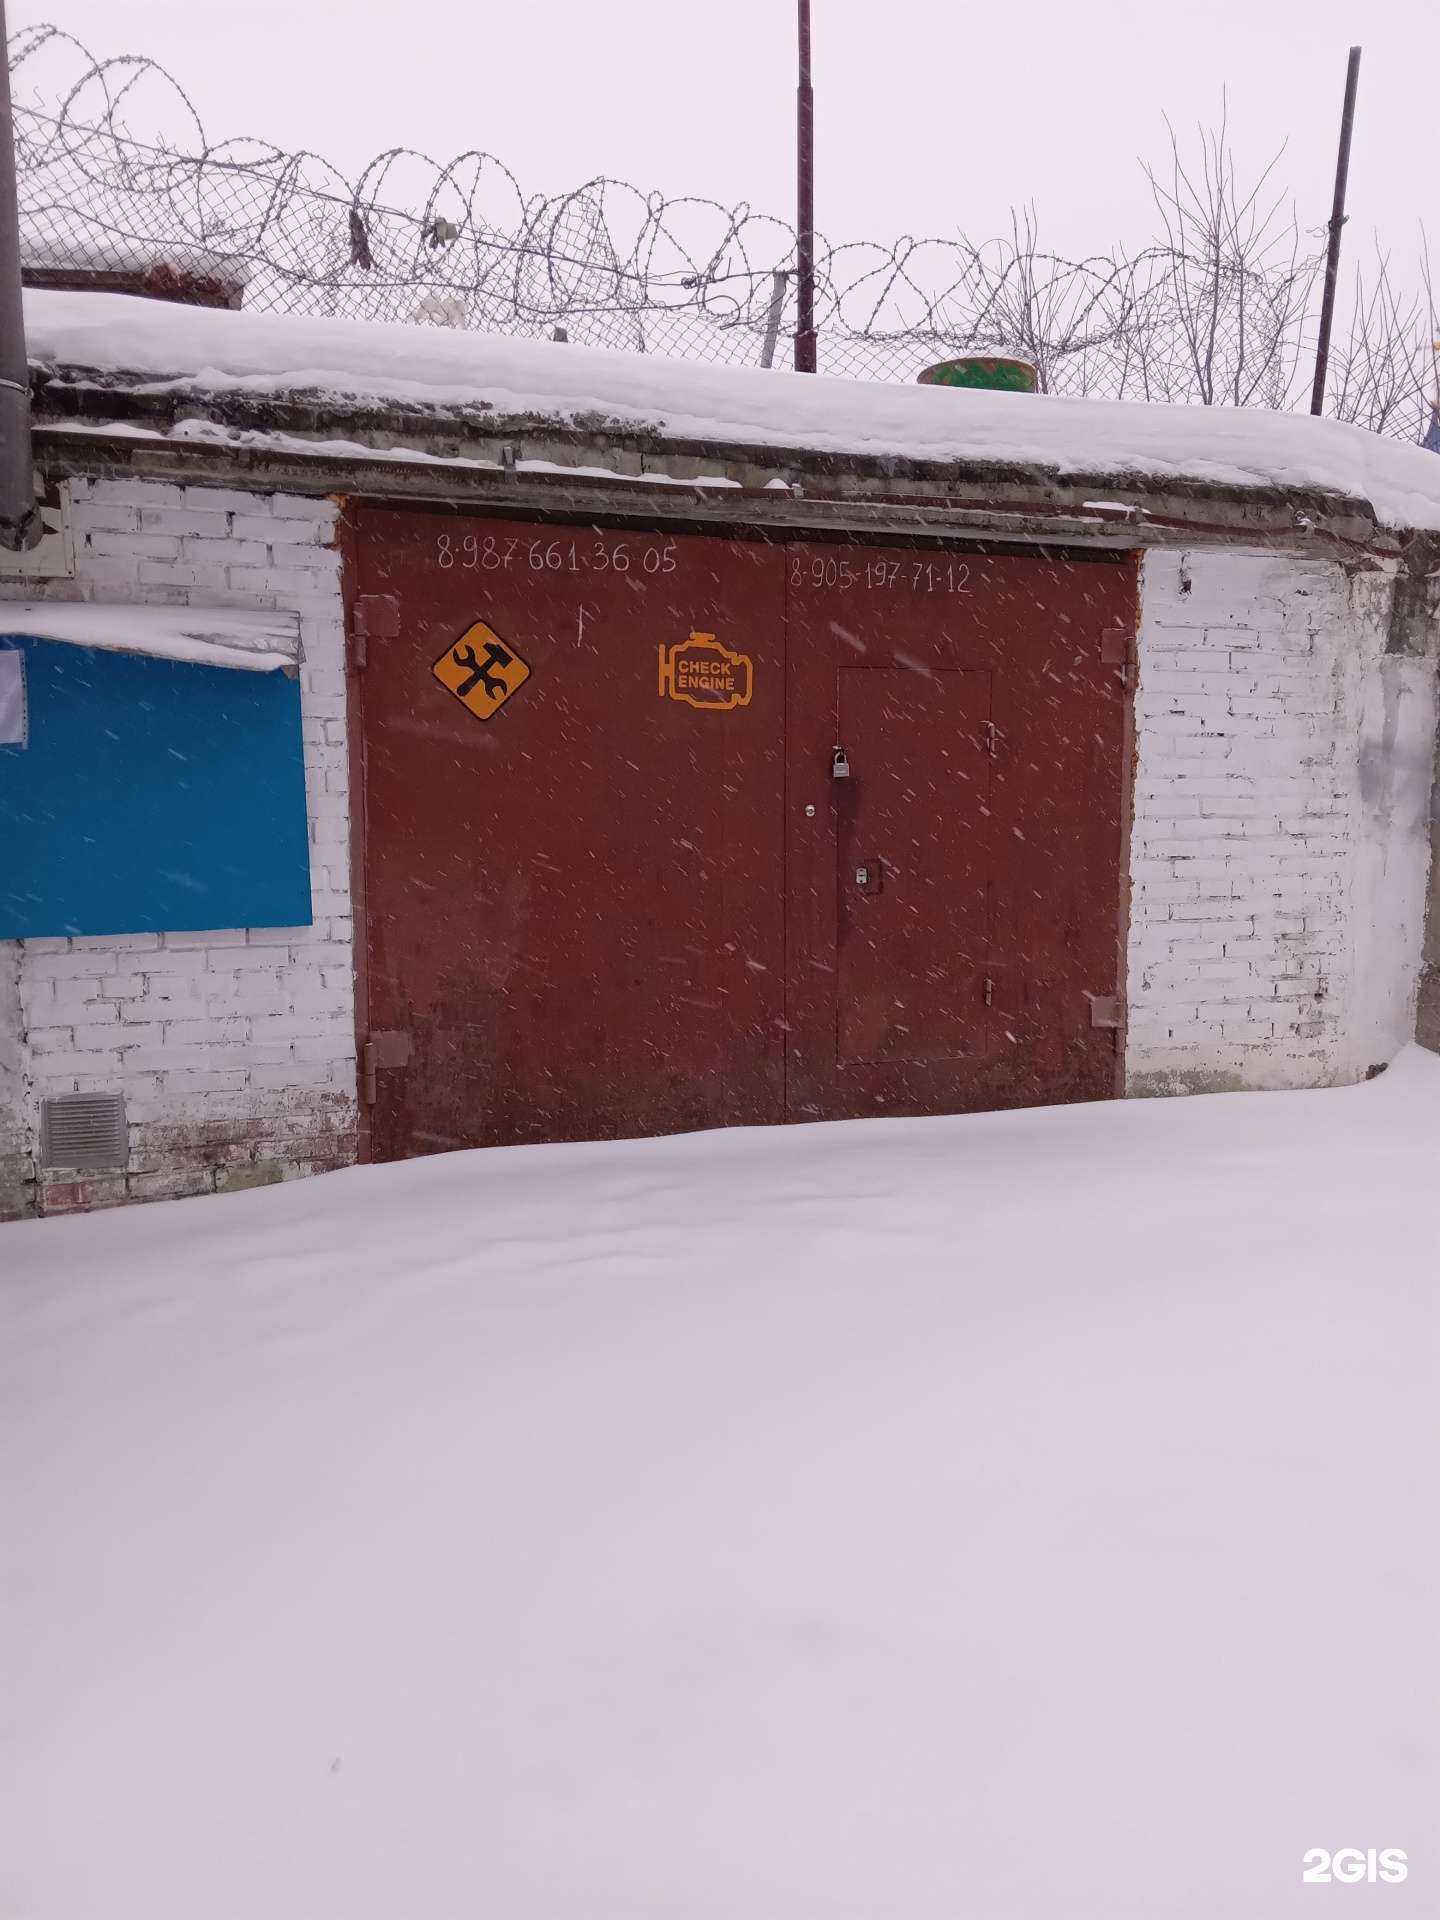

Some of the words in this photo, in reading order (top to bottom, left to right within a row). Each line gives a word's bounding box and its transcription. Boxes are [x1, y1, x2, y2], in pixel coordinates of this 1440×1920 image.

[529, 540, 580, 570] 661
[593, 542, 630, 571] 36
[643, 546, 678, 573] 05
[678, 660, 731, 675] CHECK
[678, 675, 735, 690] ENGINE
